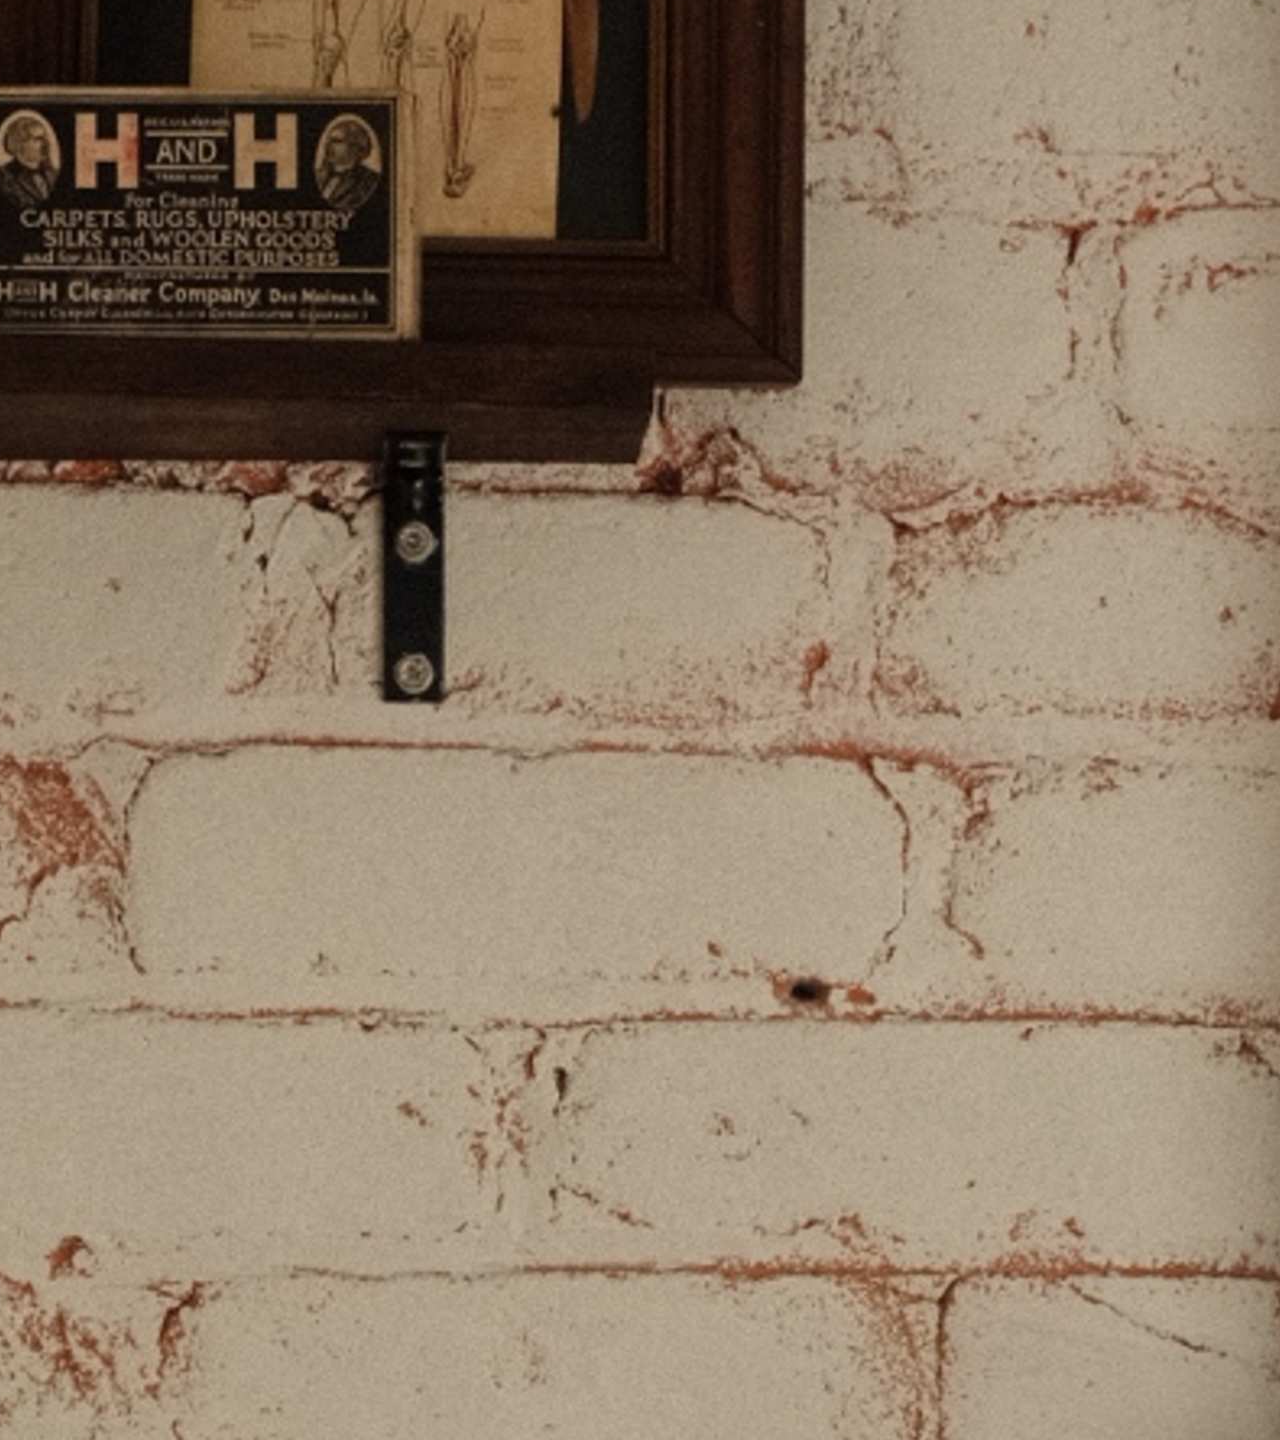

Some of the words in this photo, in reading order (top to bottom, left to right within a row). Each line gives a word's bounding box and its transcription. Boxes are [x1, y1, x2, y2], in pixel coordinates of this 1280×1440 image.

[74, 112, 139, 189] H
[155, 138, 217, 164] AND
[234, 112, 298, 189] H
[208, 210, 354, 231] UPHOLSTERY
[42, 230, 103, 248] SILKS
[110, 231, 146, 248] and
[151, 230, 249, 248] WOOLEN
[255, 230, 336, 250] GOODS
[120, 249, 229, 266] DOMESTIC
[234, 250, 340, 267] PURPOSES
[68, 281, 152, 303] Cleaner
